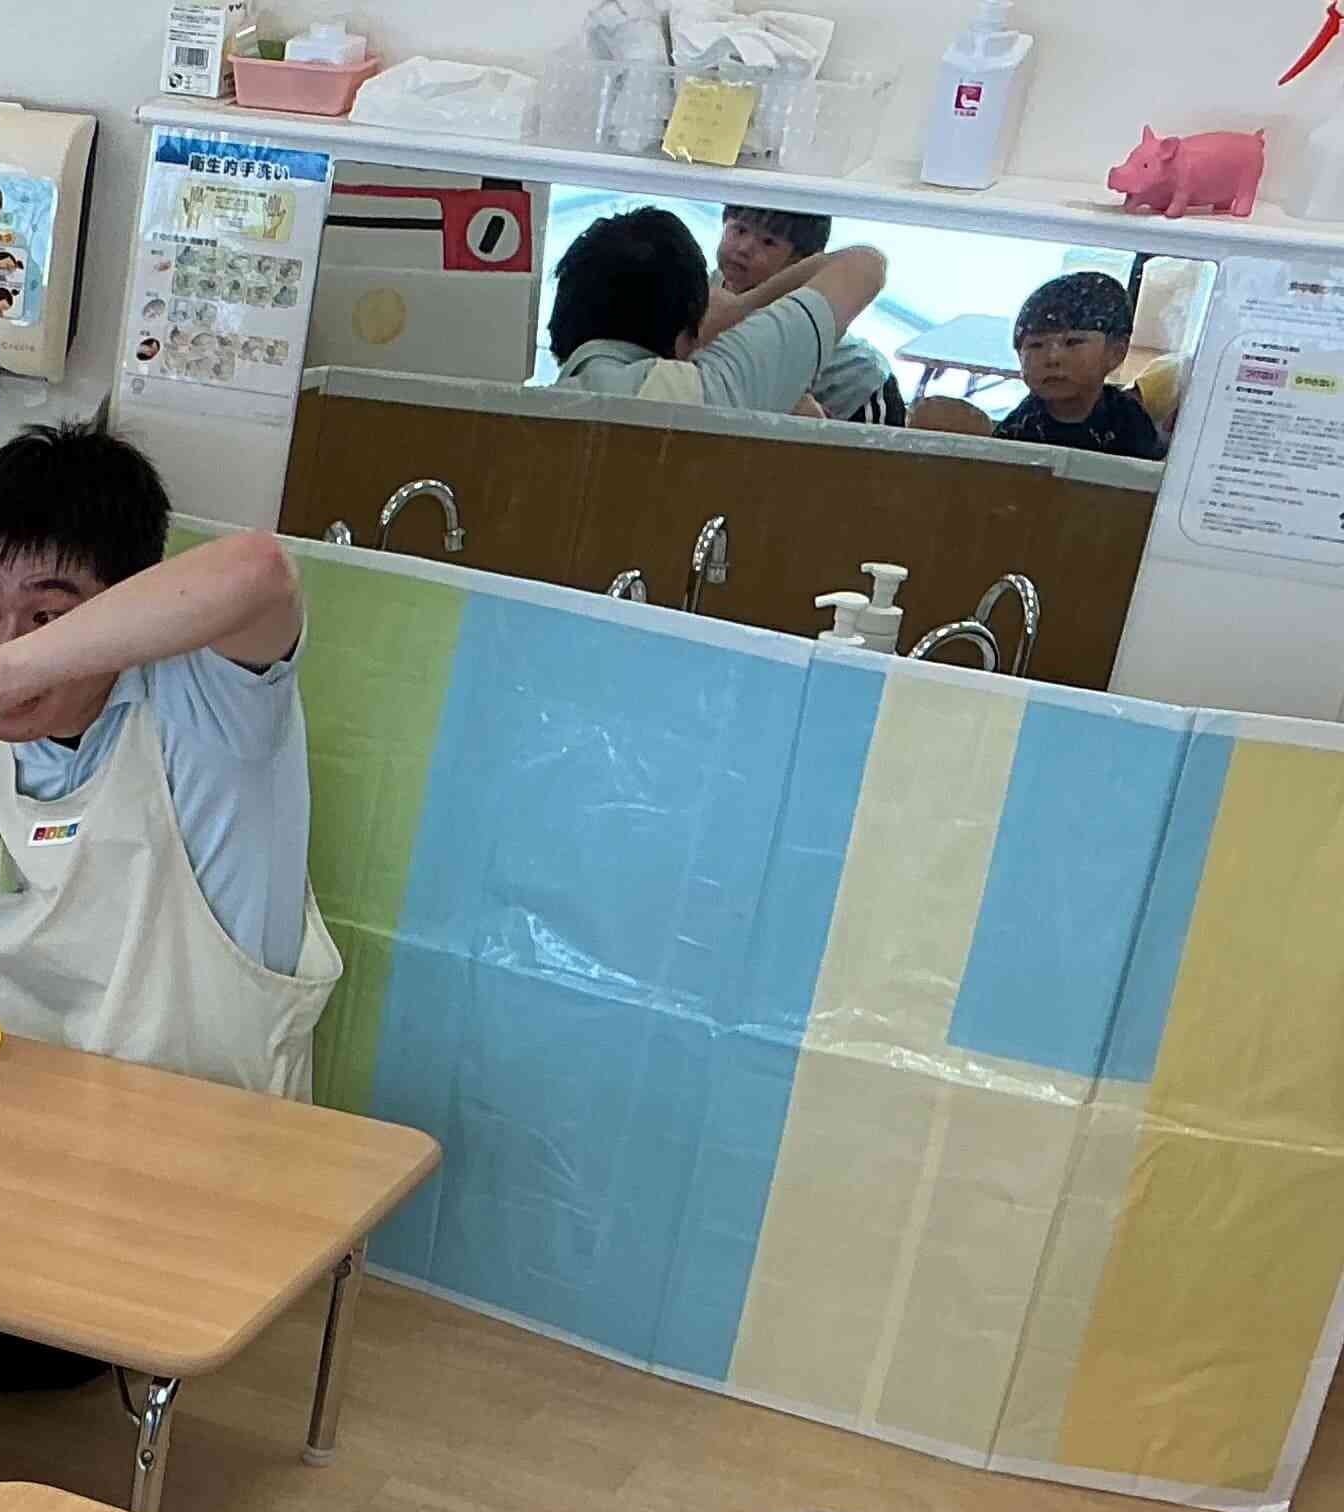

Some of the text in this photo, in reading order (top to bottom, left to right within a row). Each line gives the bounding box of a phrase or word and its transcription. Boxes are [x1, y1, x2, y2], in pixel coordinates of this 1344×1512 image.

[190, 154, 289, 180] 衛生的手洗い
